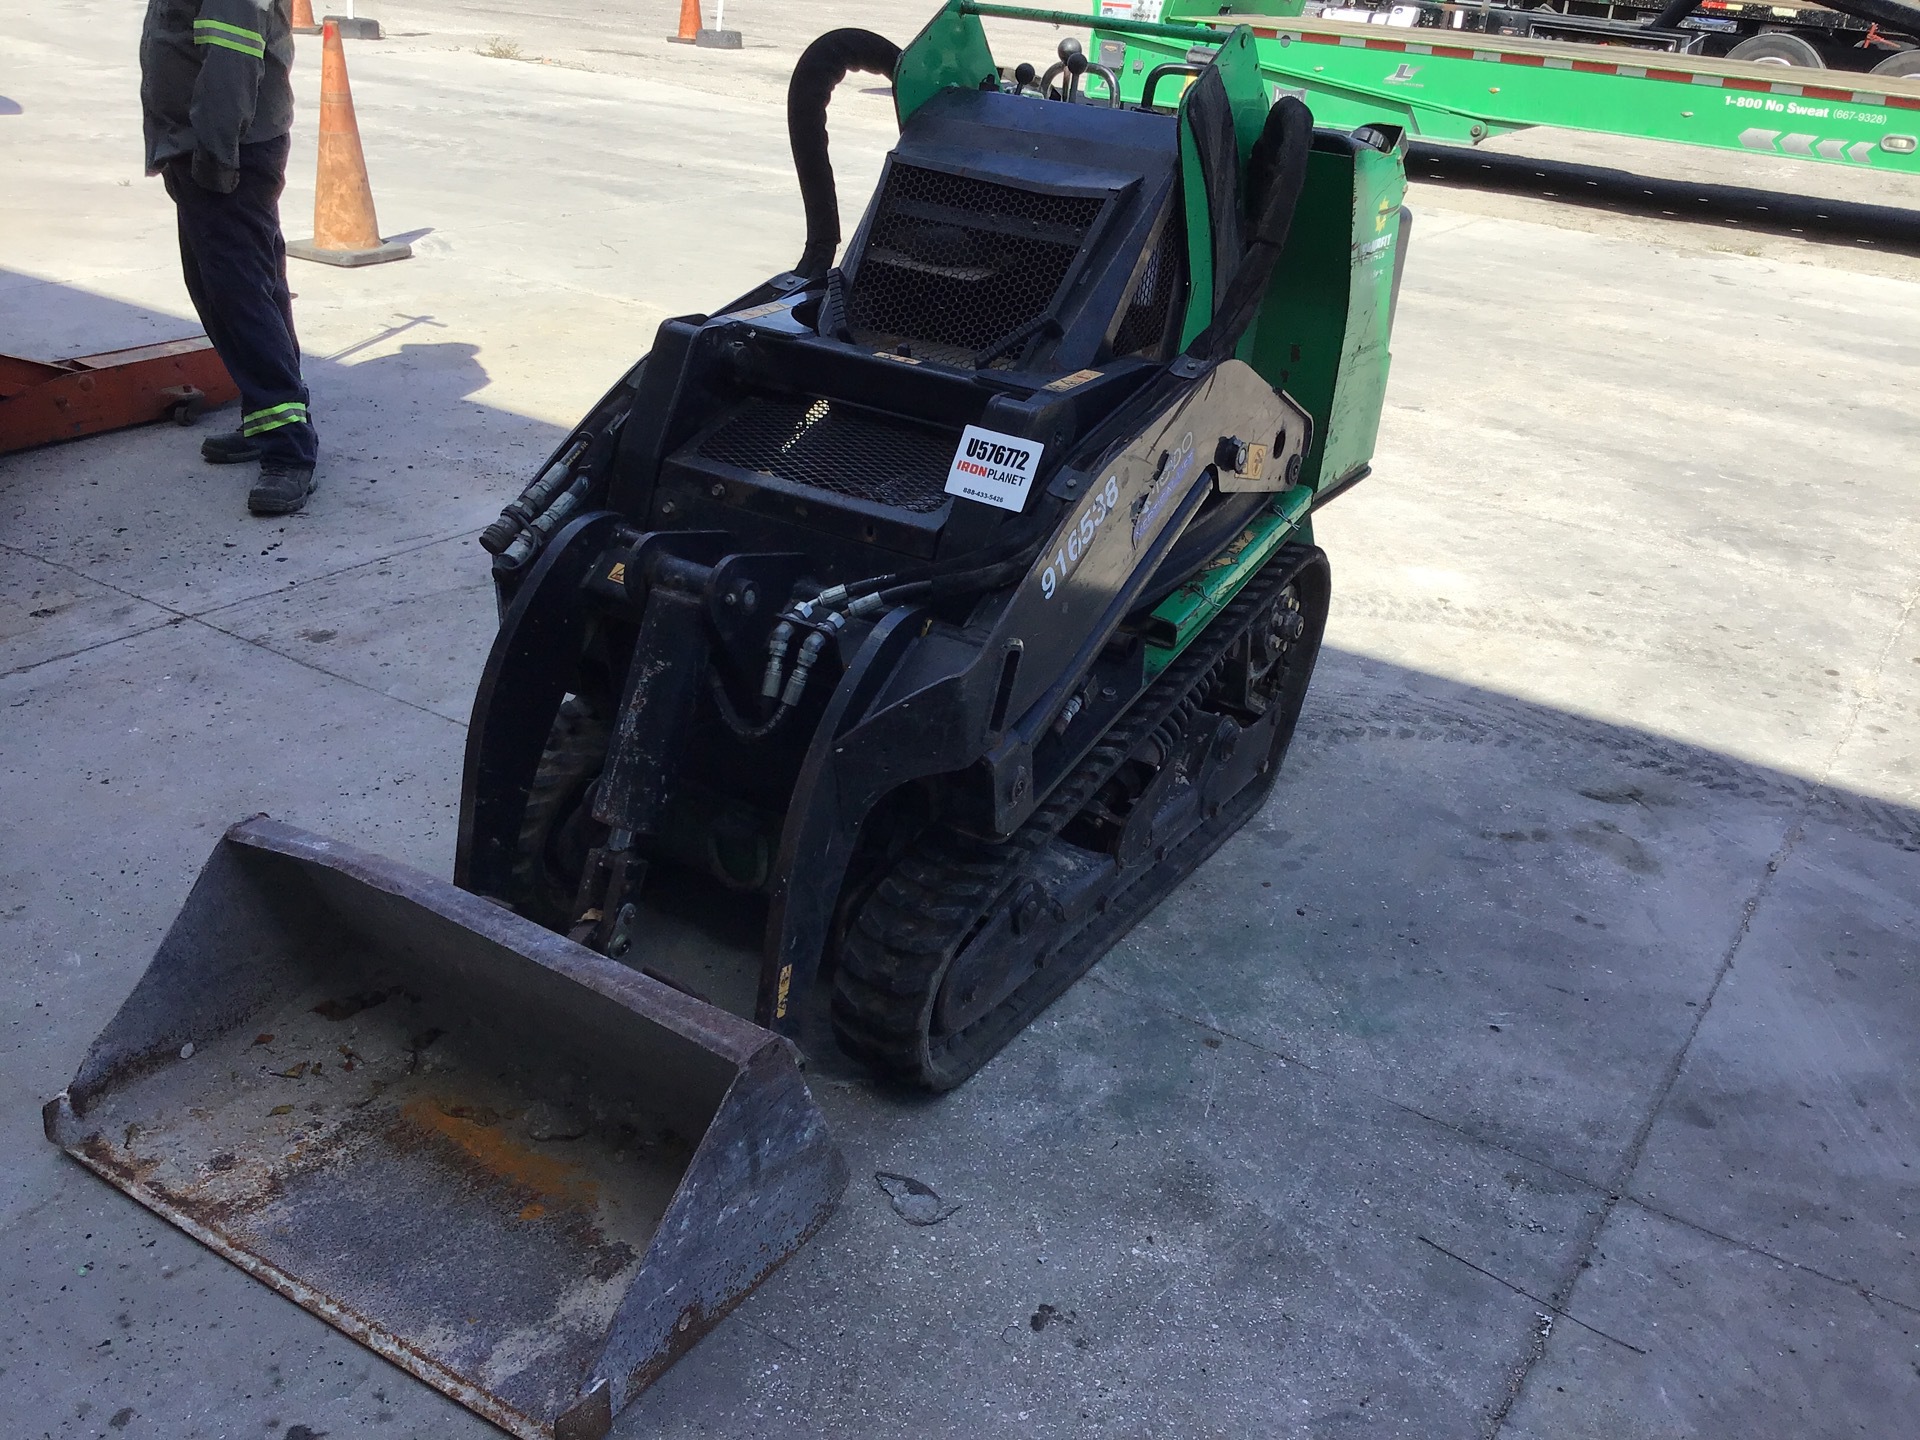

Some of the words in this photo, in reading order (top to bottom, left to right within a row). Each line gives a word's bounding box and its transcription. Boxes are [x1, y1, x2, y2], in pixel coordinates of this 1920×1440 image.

[1725, 95, 1762, 110] 1-800
[1764, 99, 1784, 112] No
[1786, 102, 1829, 118] Sweat
[1832, 108, 1887, 125] (667-9328)
[966, 437, 1030, 471] U576772
[962, 487, 1004, 503] 888-433-5426
[1041, 475, 1119, 600] 916538
